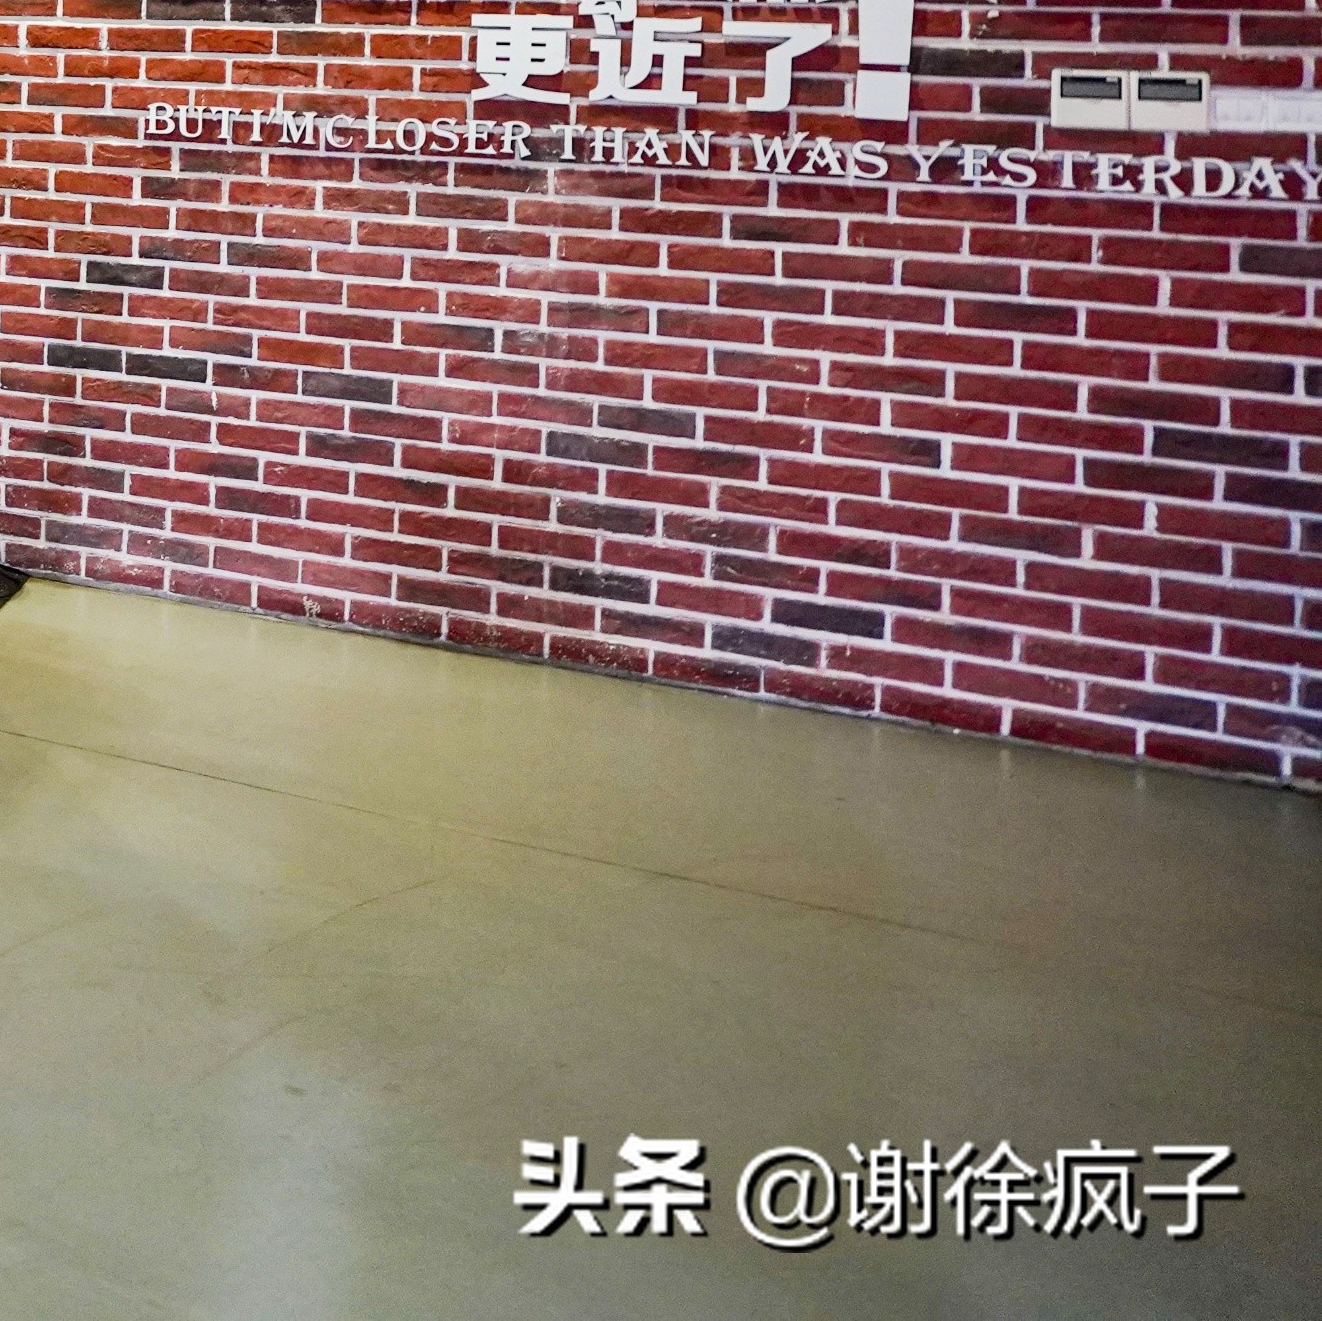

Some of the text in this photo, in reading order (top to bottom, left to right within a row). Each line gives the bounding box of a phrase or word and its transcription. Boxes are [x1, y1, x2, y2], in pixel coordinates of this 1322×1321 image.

[145, 102, 243, 139] BUT
[325, 113, 533, 158] CLOSER
[551, 123, 715, 166] THAN
[749, 131, 889, 178] WAS
[905, 139, 1322, 201] YESTERDAY
